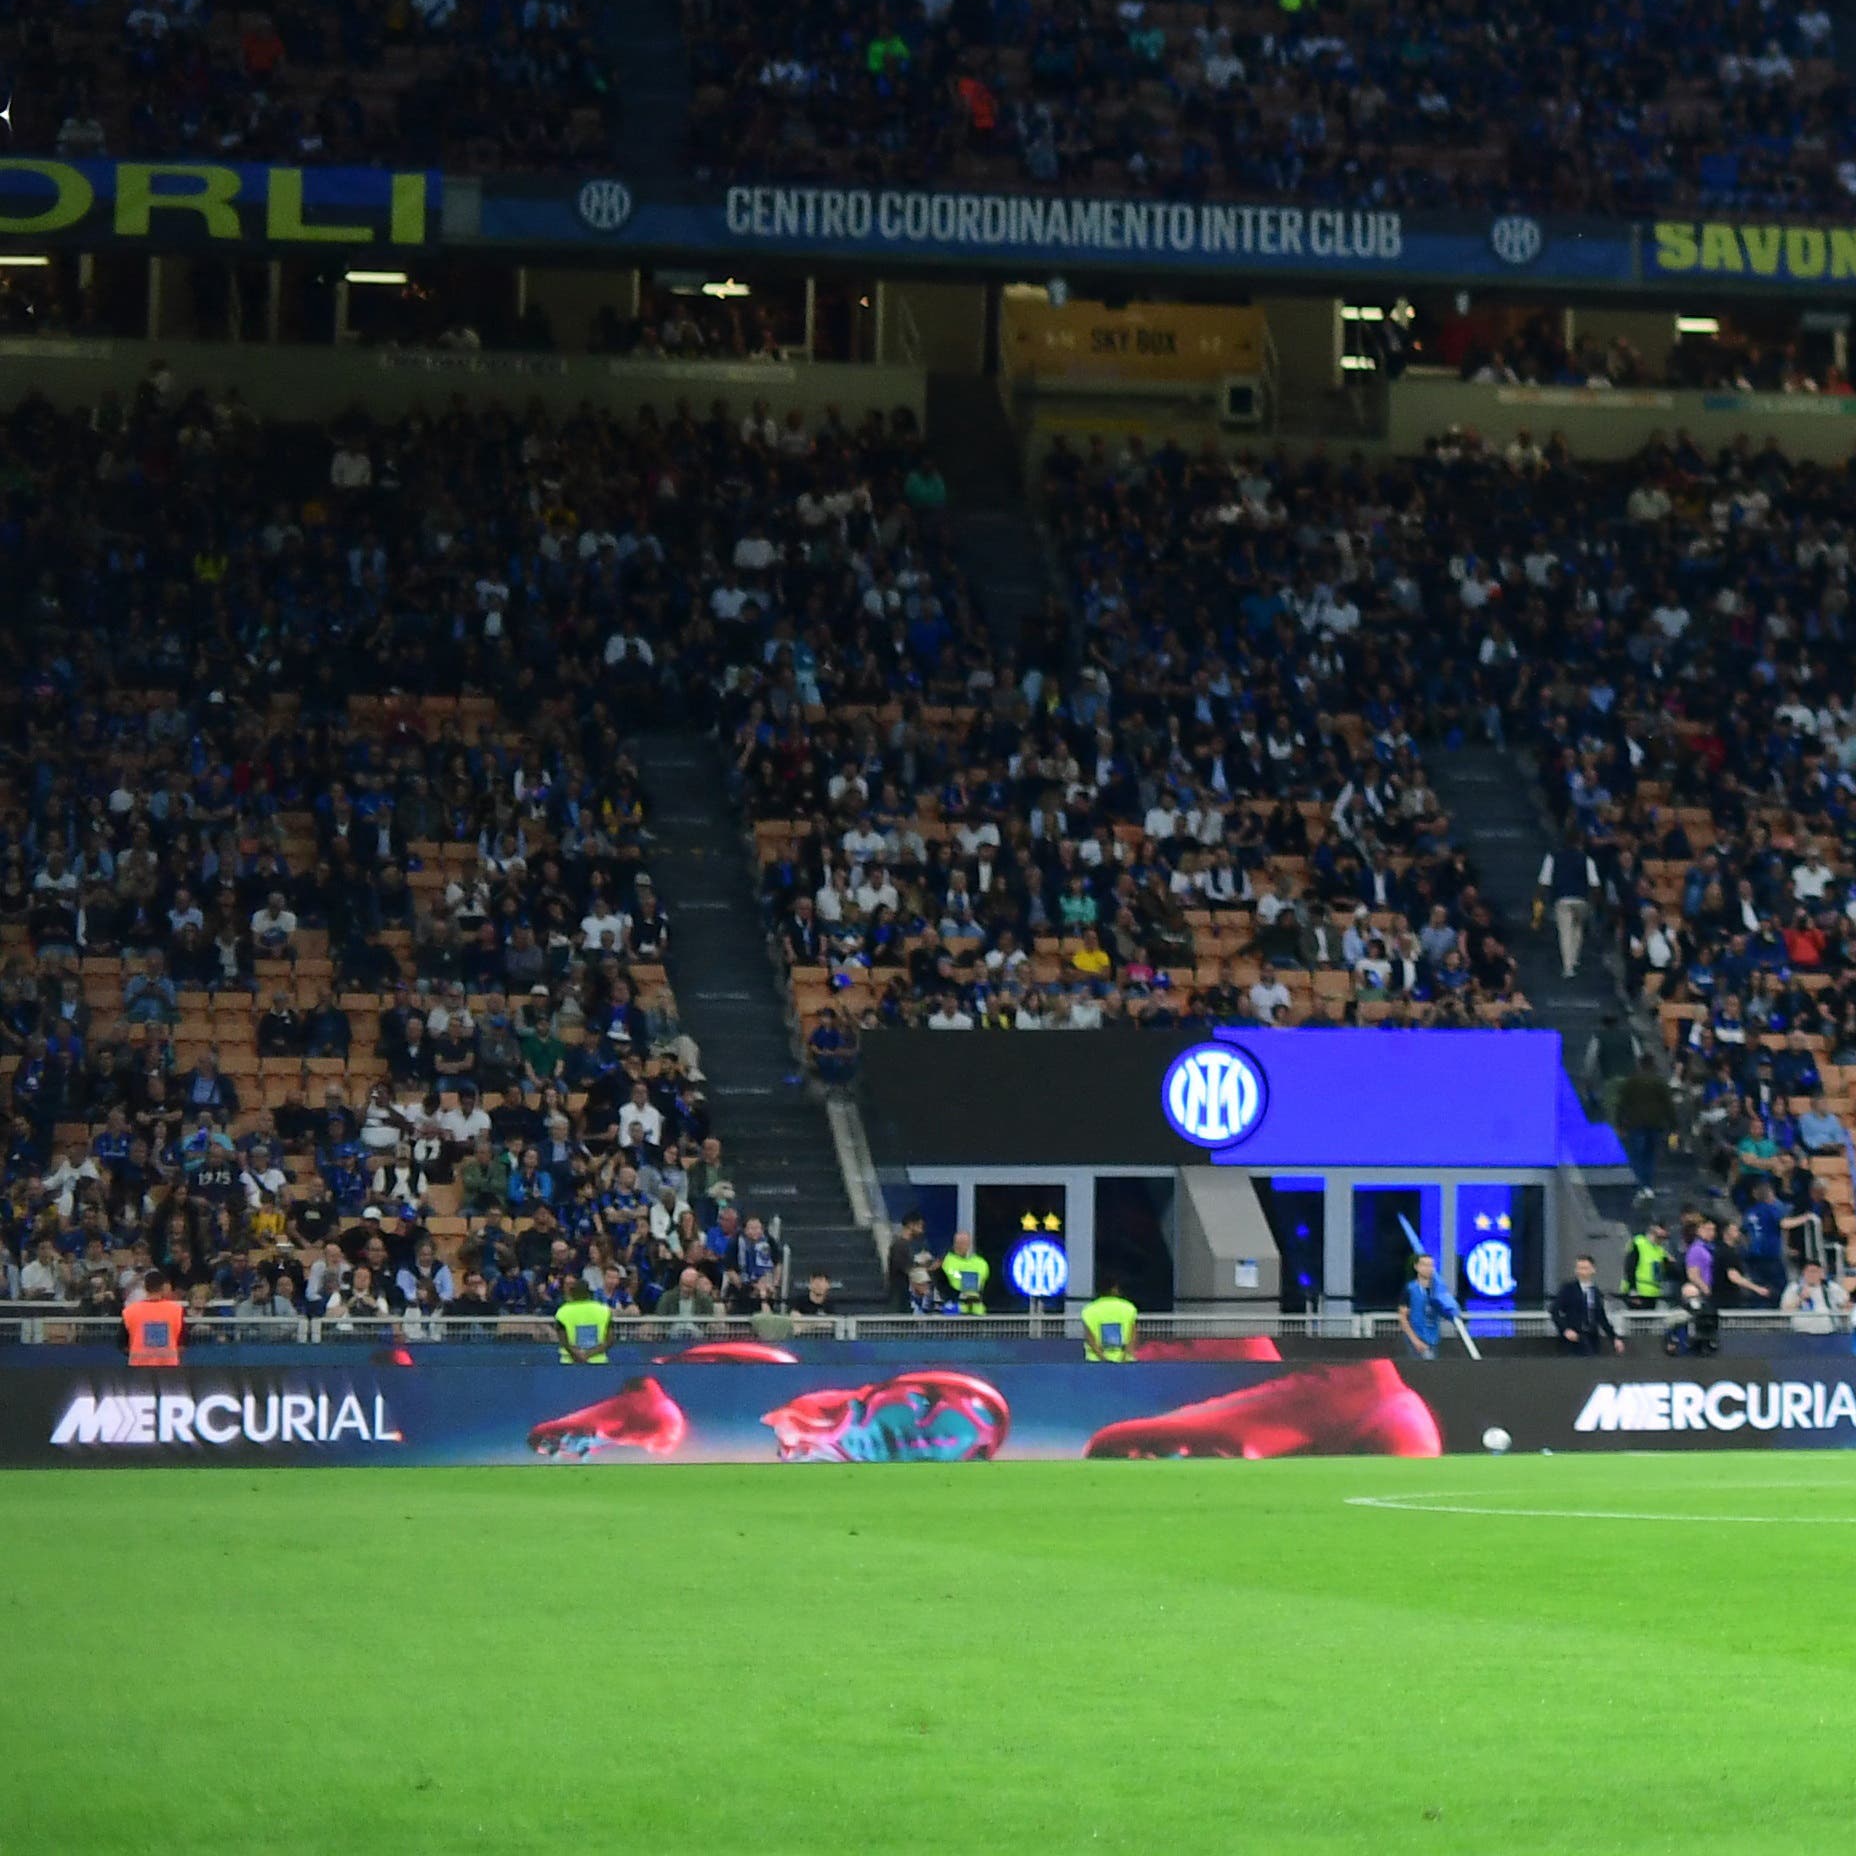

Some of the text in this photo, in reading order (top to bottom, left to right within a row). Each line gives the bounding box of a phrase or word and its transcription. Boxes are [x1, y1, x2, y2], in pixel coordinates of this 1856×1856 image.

[726, 184, 1401, 258] CENTRO COORDINAMENTO INTER CLUB
[49, 1394, 401, 1443] MERCURIAL
